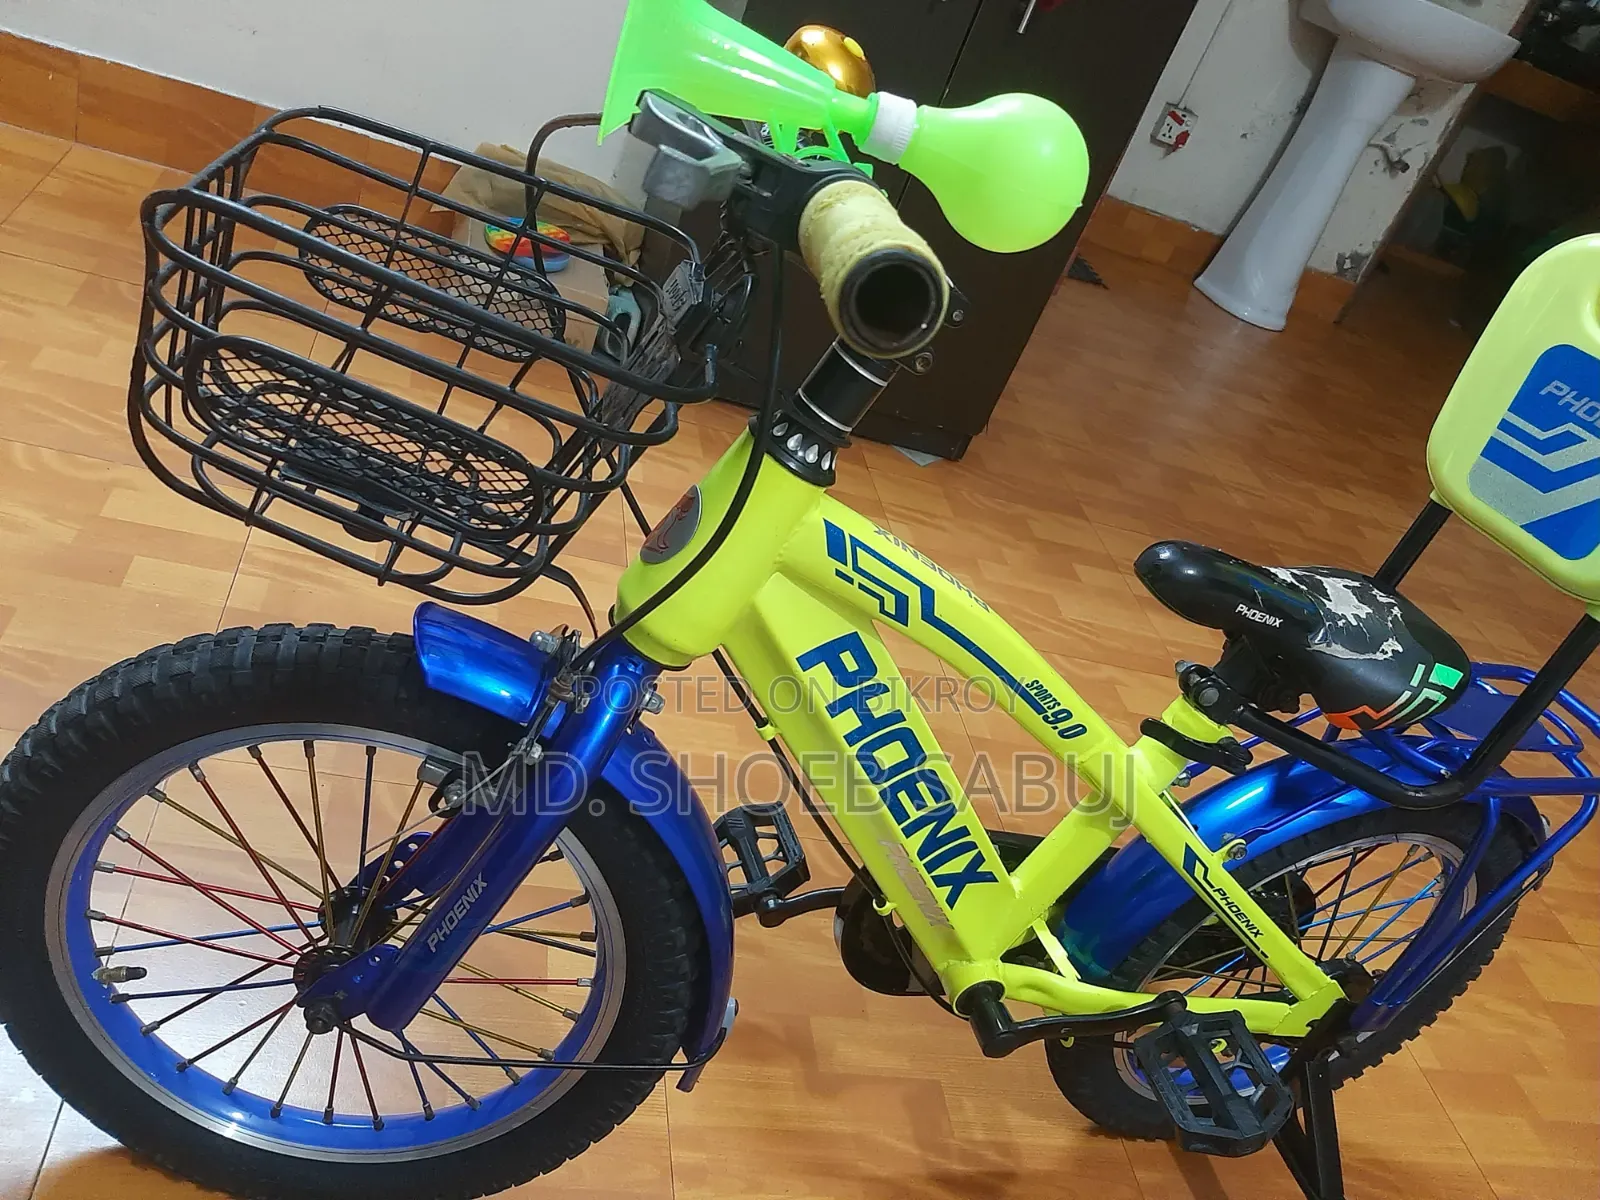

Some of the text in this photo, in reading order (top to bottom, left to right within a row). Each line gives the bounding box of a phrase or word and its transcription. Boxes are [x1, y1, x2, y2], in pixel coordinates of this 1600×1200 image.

[1538, 379, 1600, 429] PHO
[873, 523, 991, 613] PHOENIX
[1235, 603, 1284, 628] PHOENIX
[1025, 679, 1088, 740] SPORTS 9.0
[796, 631, 999, 910] PHOENIX
[427, 871, 488, 953] PHOENIX
[1213, 887, 1264, 938] PHOENIX
